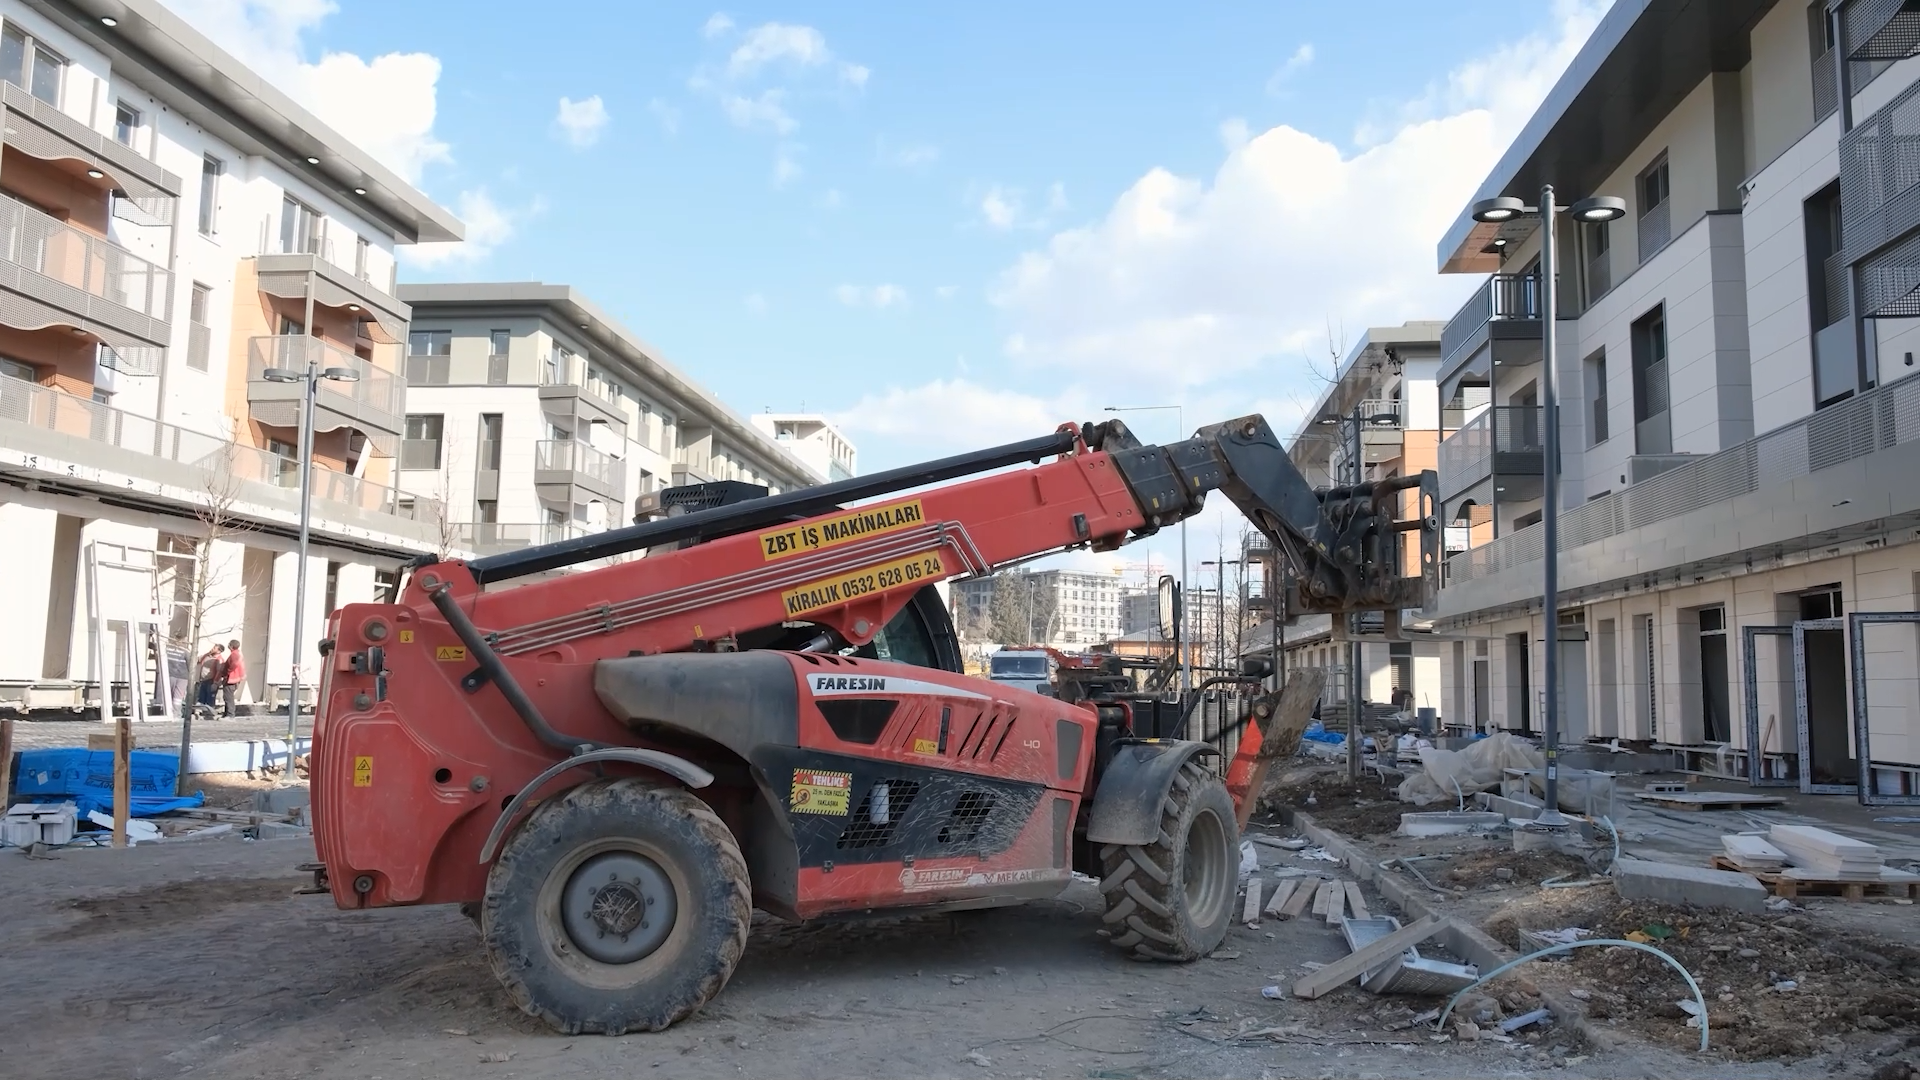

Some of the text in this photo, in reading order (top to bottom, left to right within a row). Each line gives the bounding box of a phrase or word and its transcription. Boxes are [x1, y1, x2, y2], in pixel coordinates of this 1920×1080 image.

[765, 504, 921, 555] ZBT İŞ MAKİNALARI
[787, 557, 941, 614] KİRALIK 0532 628 05 24
[817, 677, 886, 691] FARESIN
[1023, 739, 1041, 749] 40
[918, 869, 965, 882] FARESIN
